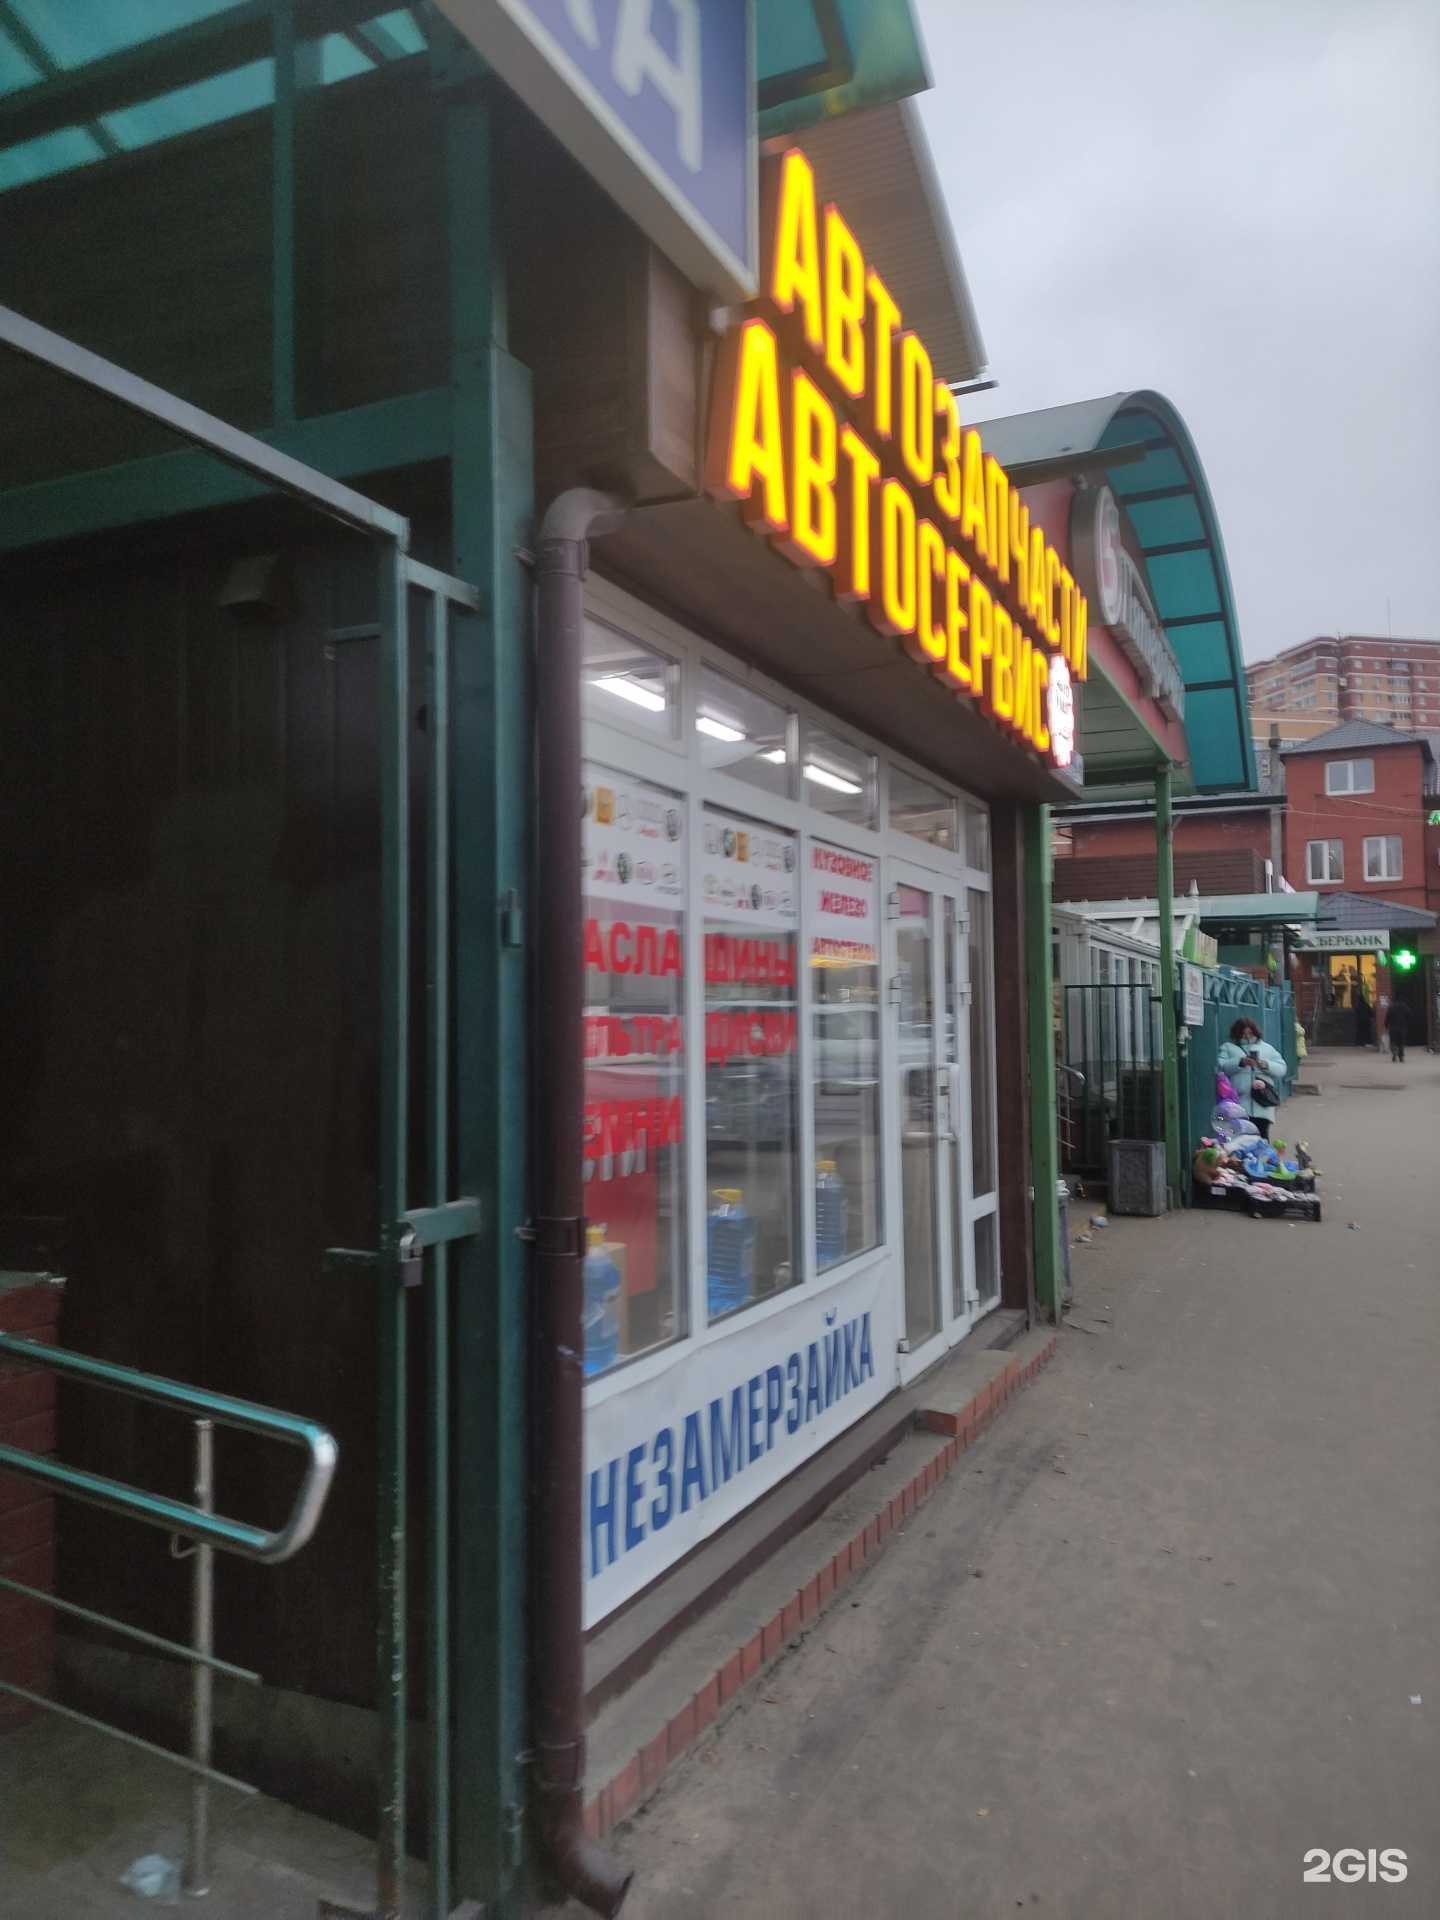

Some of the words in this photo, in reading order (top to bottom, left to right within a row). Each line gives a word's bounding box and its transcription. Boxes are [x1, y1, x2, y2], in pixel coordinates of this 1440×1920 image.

[727, 317, 1050, 753] АВТОСЕРВИС
[773, 147, 1088, 682] АВТОЗАПЧАСТИ
[590, 1307, 874, 1578] НЕЗАМЕРЗАЙКА
